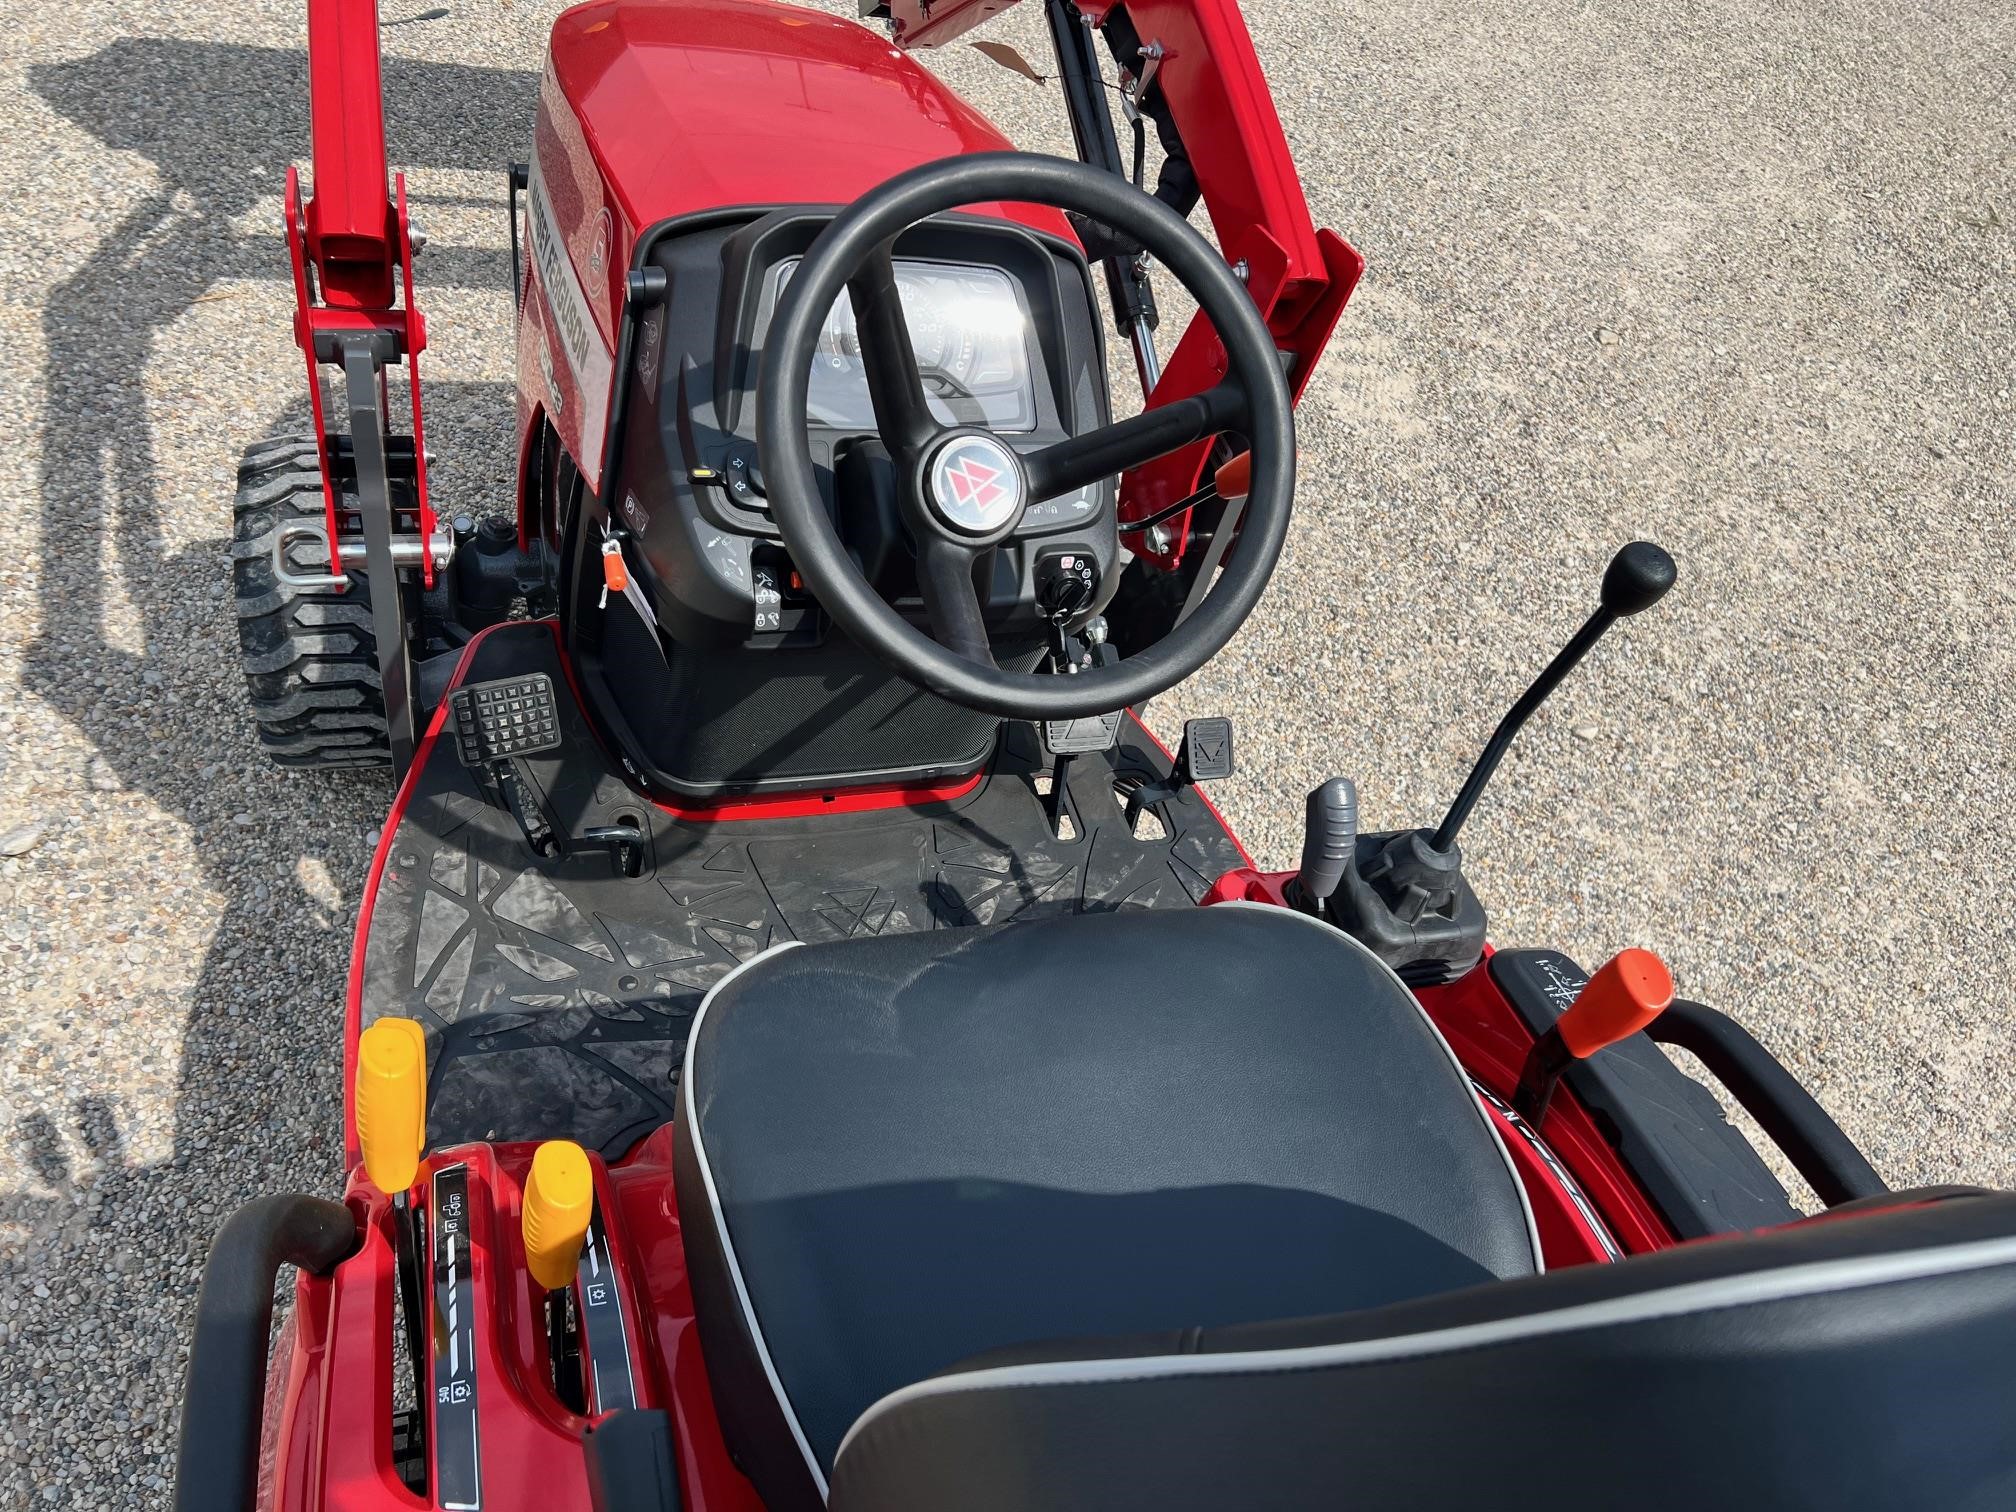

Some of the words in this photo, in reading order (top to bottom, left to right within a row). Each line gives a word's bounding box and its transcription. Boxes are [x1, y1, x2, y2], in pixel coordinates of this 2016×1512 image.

[532, 179, 550, 260] MASSEY
[546, 242, 591, 373] FERGUSON
[1502, 1111, 1520, 1122] N
[438, 1386, 450, 1403] 540
